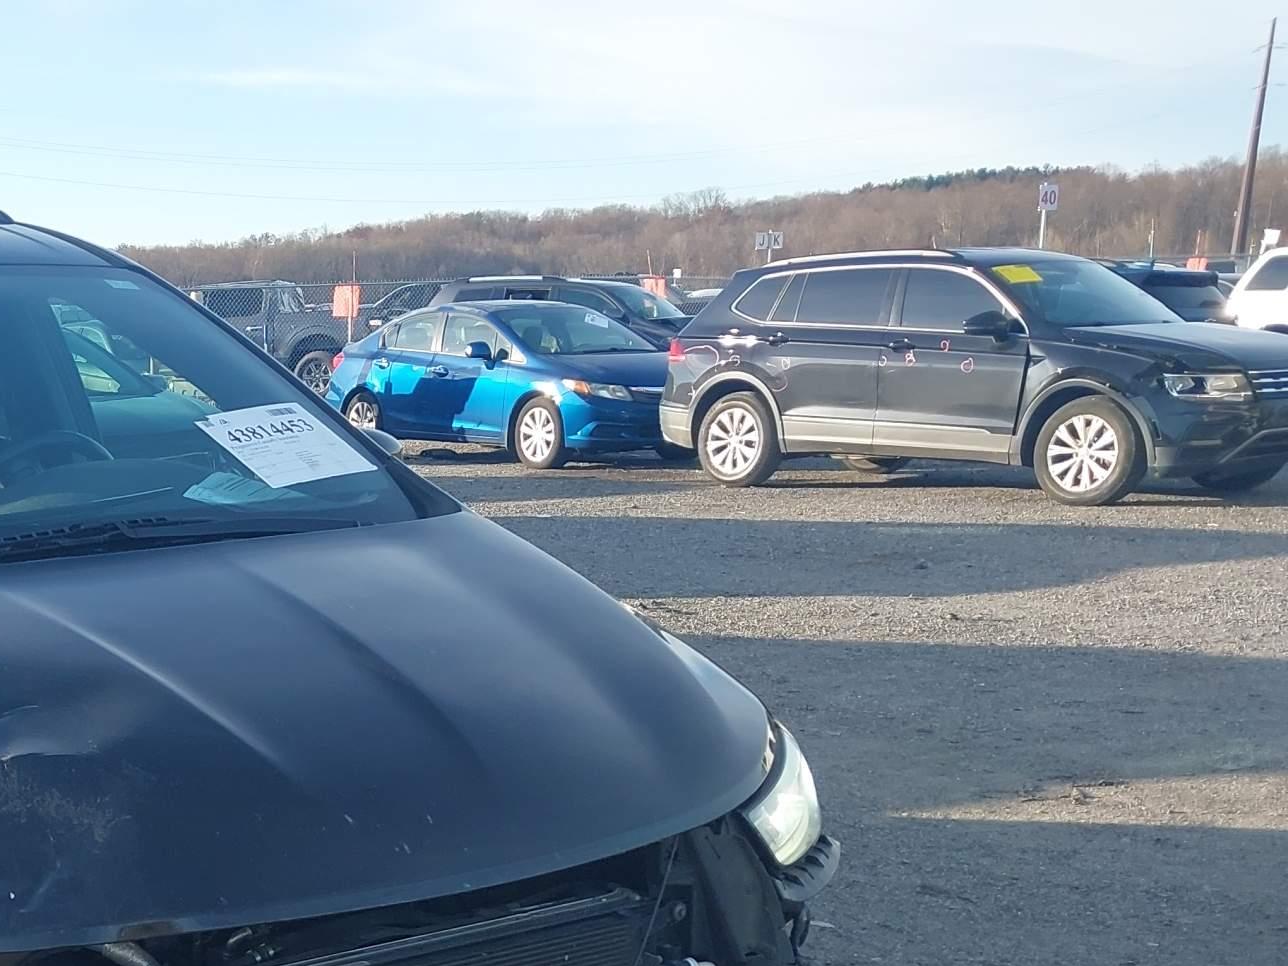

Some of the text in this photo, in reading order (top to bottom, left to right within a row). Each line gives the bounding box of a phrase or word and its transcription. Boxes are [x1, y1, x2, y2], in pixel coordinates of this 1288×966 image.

[1041, 190, 1057, 205] 40
[758, 234, 765, 246] J
[773, 234, 781, 246] K
[227, 418, 314, 443] 43814453
